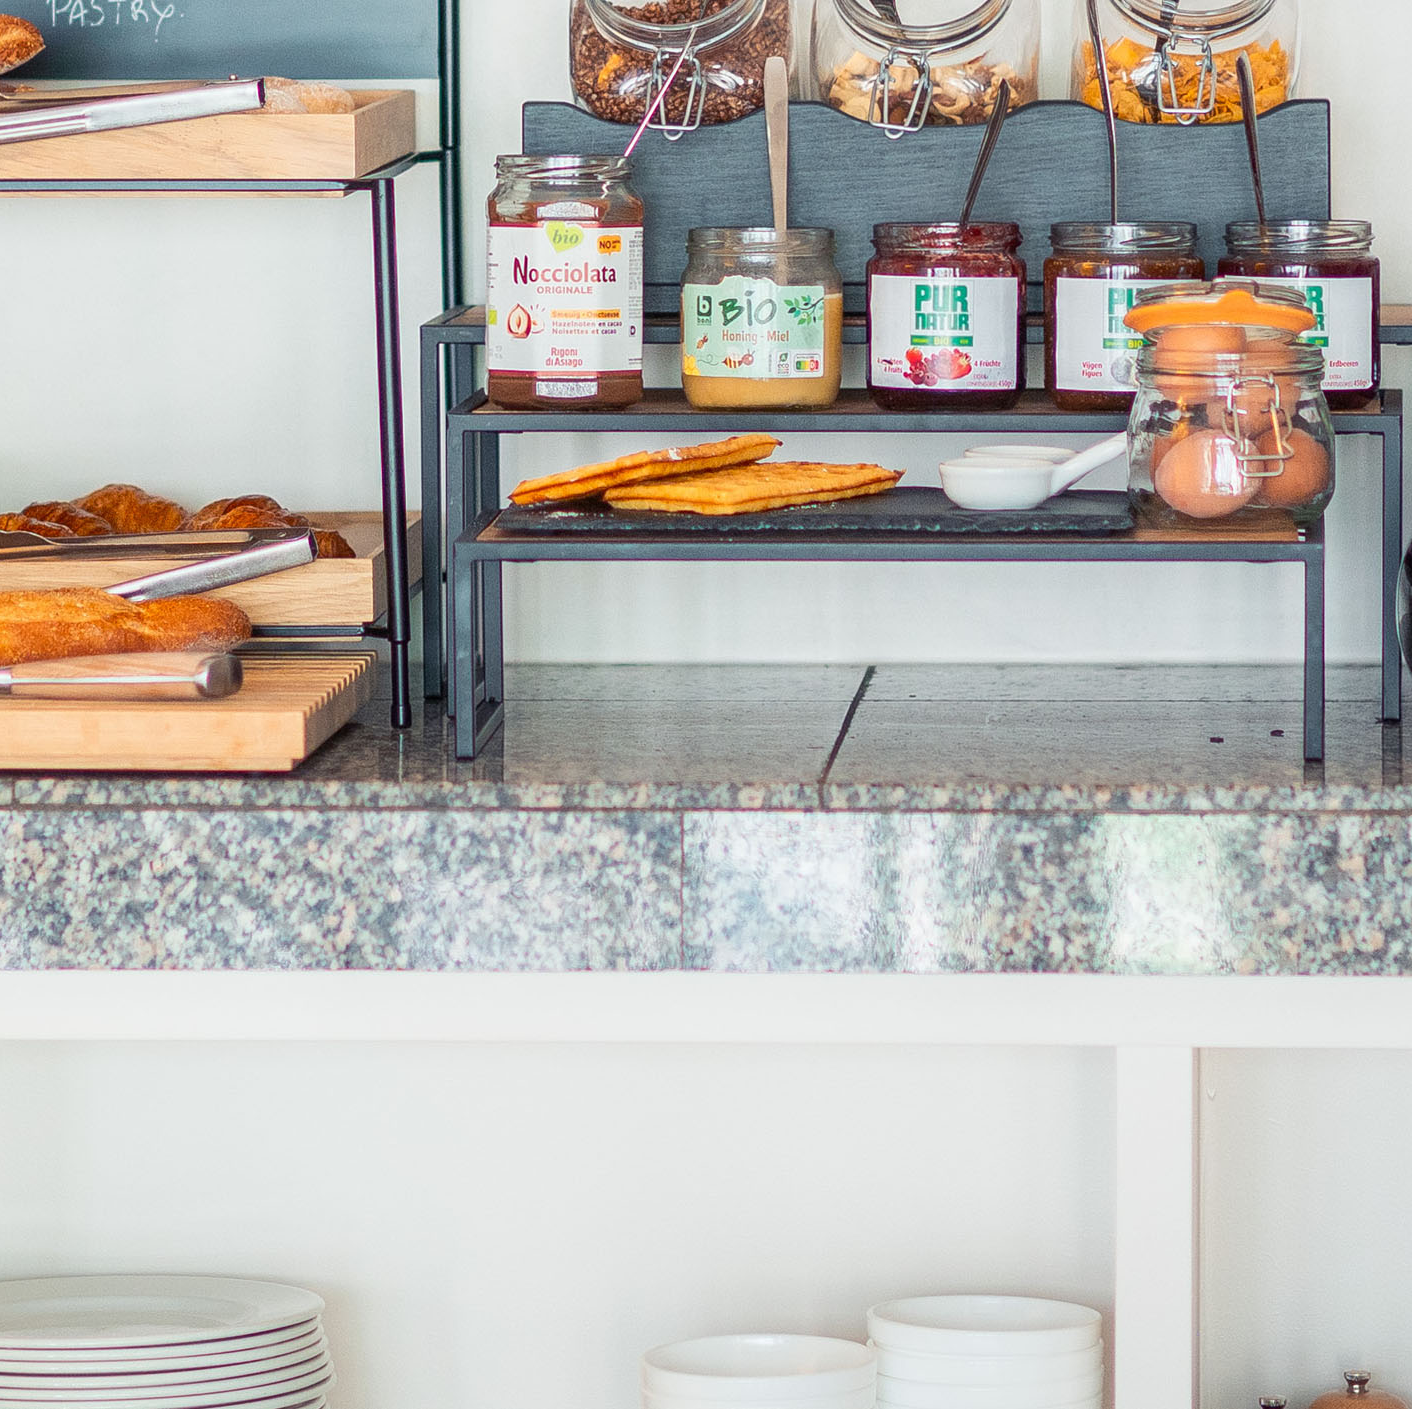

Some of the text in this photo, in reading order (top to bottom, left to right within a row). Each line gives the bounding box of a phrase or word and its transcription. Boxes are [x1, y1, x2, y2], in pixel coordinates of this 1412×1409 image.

[552, 230, 579, 245] bio
[599, 240, 612, 250] NO
[513, 255, 617, 285] Nocciolata
[536, 286, 593, 294] ORIGINALE
[914, 284, 969, 313] PUR
[915, 312, 970, 331] NATUR
[721, 329, 758, 344] Honing
[766, 329, 790, 342] Miel
[550, 347, 578, 358] Rigoni
[545, 357, 584, 368] di Asiago
[1081, 361, 1103, 370] Vijgen
[1328, 360, 1359, 368] Erdbeeren
[1081, 370, 1103, 378] Figues
